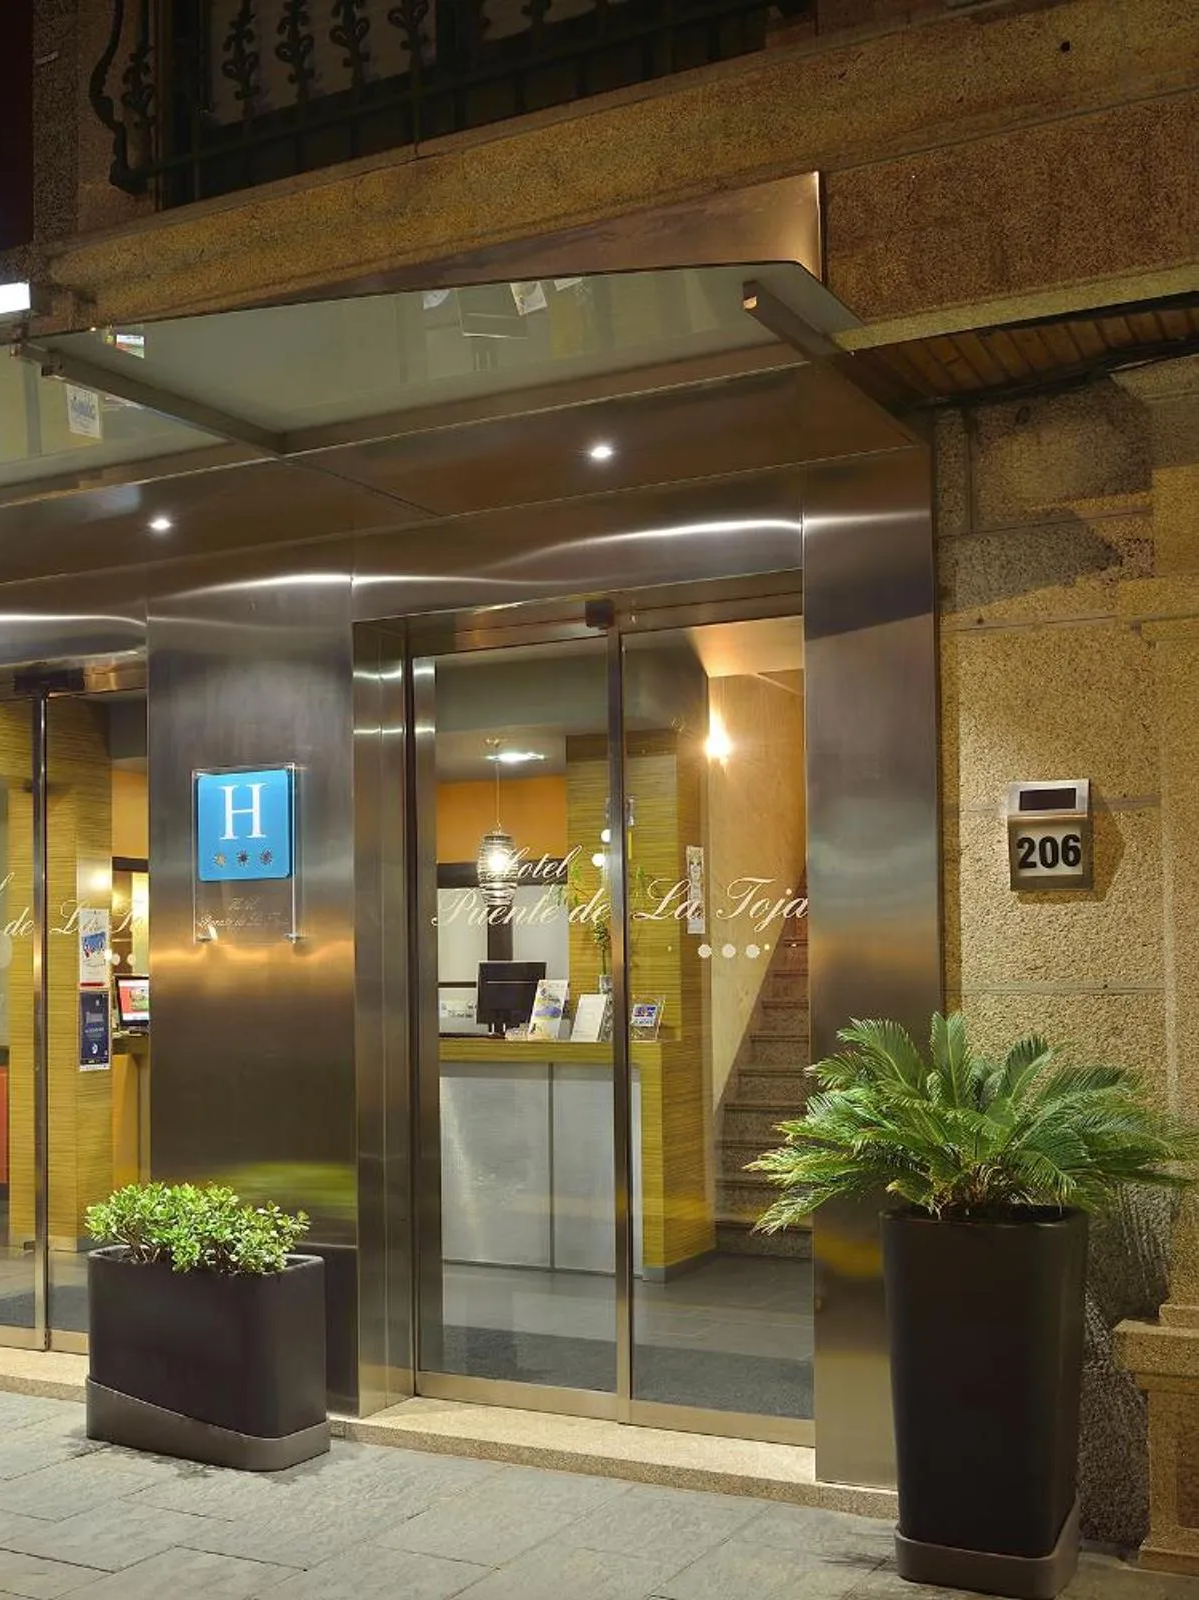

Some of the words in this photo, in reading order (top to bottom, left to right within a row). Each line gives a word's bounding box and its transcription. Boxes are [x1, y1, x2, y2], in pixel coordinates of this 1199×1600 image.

[217, 782, 269, 841] H
[1016, 834, 1081, 869] 206
[3, 906, 34, 936] de
[431, 884, 560, 927] Puente
[569, 888, 612, 924] de
[632, 878, 705, 920] La
[715, 877, 808, 933] Toja
